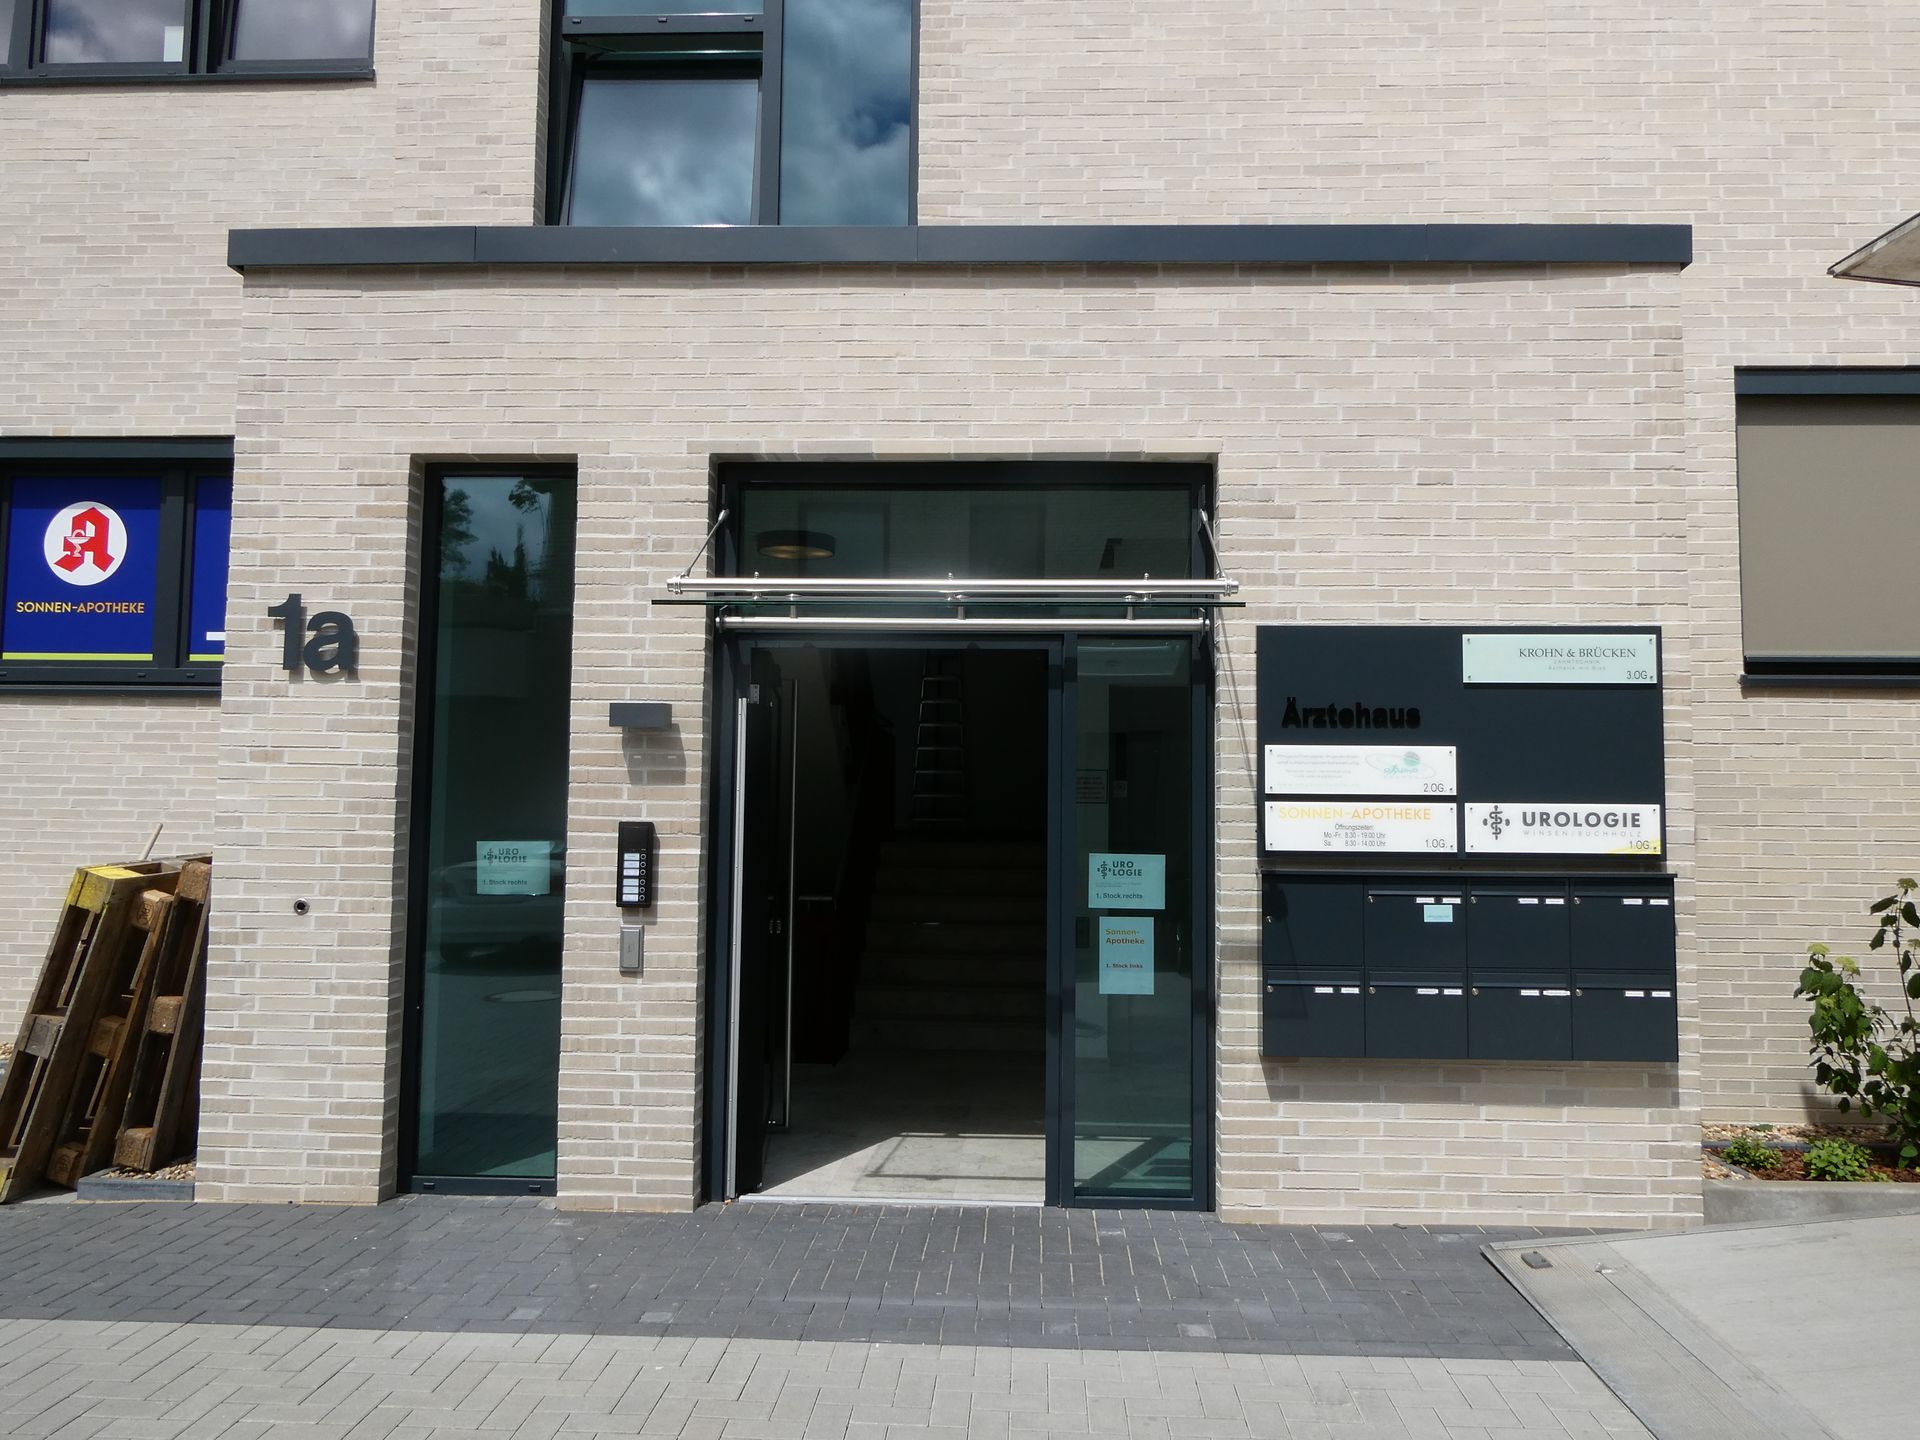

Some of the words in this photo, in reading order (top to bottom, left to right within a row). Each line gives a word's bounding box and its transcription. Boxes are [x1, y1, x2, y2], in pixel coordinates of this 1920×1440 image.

[16, 601, 145, 614] SONNEN-APOTHEKE
[267, 593, 358, 673] 1a
[1518, 648, 1563, 658] KROHN
[1566, 648, 1576, 658] &
[1578, 646, 1637, 658] BRÜCKEN
[1281, 696, 1421, 729] Ärztehaus
[1521, 811, 1641, 828] UROLOGIE
[498, 847, 519, 856] URO
[498, 855, 528, 863] LOGIE
[1112, 860, 1134, 869] URO
[1112, 869, 1143, 877] LOGIE
[1105, 928, 1140, 936] Sonnen-
[1106, 937, 1145, 946] Apotheke
